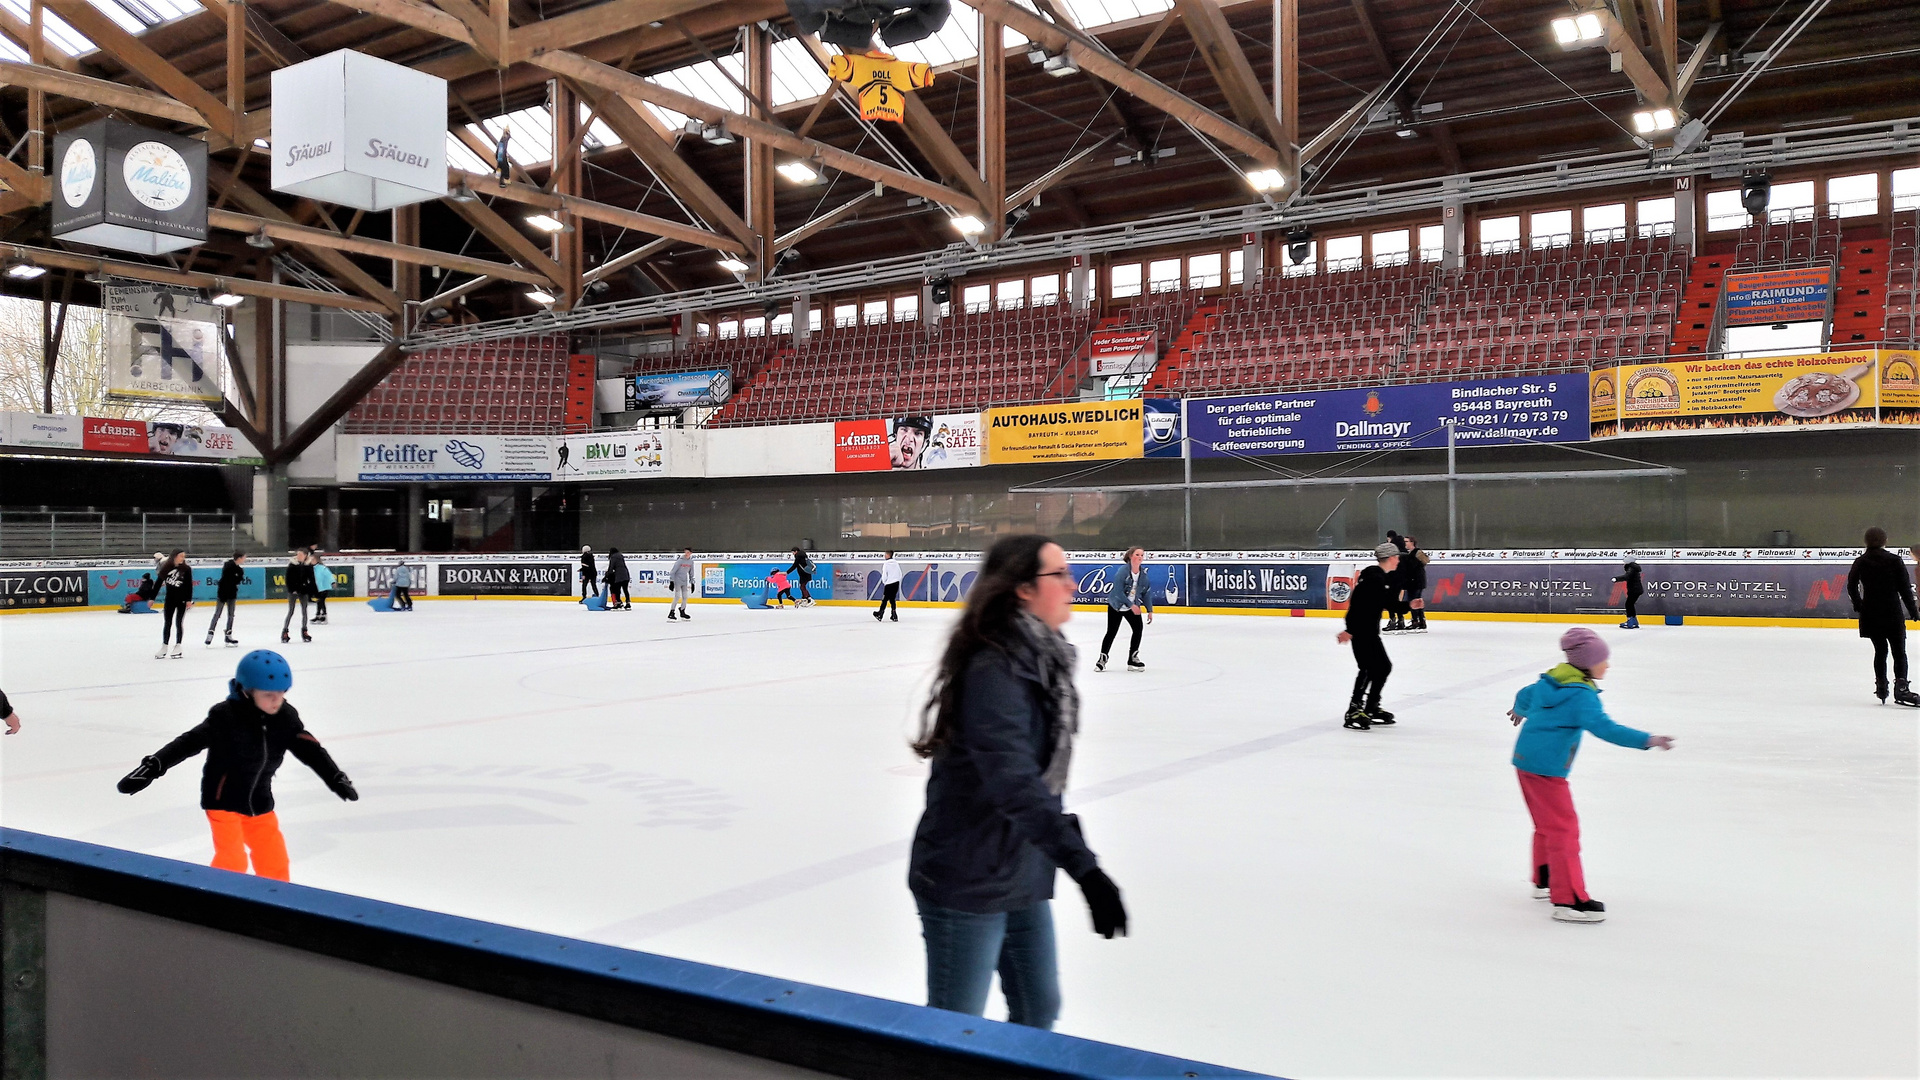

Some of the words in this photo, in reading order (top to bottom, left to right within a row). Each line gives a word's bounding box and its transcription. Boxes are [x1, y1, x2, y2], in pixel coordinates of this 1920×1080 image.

[872, 70, 891, 79] DOLL
[879, 86, 888, 105] 5
[286, 141, 332, 167] STÄUBLI
[364, 138, 429, 168] STÄUBLI
[130, 164, 186, 190] Malibu
[1676, 178, 1689, 190] M
[1246, 233, 1252, 243] L
[1074, 257, 1080, 267] L
[924, 276, 931, 284] K
[1751, 297, 1775, 306] Heizöl
[1781, 296, 1806, 304] Diesel
[1111, 336, 1135, 344] Sonntag
[1685, 364, 1702, 373] Wir
[1705, 362, 1742, 373] backen
[1745, 362, 1763, 370] das
[1766, 359, 1795, 368] echte
[1797, 355, 1867, 367] Holzofenbrot
[1452, 384, 1519, 399] Bindlacher
[1522, 383, 1545, 394] Str.
[1548, 382, 1557, 393] 5
[1207, 404, 1226, 413] Der
[1228, 401, 1272, 414] perfekte
[1275, 399, 1316, 410] Partner
[1453, 400, 1492, 412] 95448
[1495, 398, 1552, 410] Bayreuth
[992, 408, 1140, 428] AUTOHAUS.WEDLICH
[1218, 416, 1233, 426] für
[1236, 415, 1252, 424] die
[1254, 412, 1301, 424] optimale
[1438, 416, 1466, 427] Tel.:
[1468, 414, 1499, 426] 0921
[1503, 413, 1509, 424] /
[1513, 412, 1529, 423] 79
[1532, 411, 1548, 422] 73
[1552, 410, 1568, 421] 79
[33, 424, 67, 432] Pathologie
[951, 428, 977, 437] PLAY-
[1028, 431, 1059, 439] BAYREUTH
[1065, 429, 1099, 437] KULMBACH
[1228, 427, 1292, 438] betriebliche
[1336, 421, 1412, 437] Dallmayr
[1453, 426, 1558, 440] www.dallmayr.de
[205, 440, 234, 450] SAFE
[946, 436, 977, 448] SAFE
[1212, 439, 1305, 452] Kaffeeversorgung
[1337, 442, 1372, 450] VENDING
[362, 443, 438, 462] Pfeiffer
[586, 443, 611, 459] BiV
[1032, 451, 1095, 459] www.autohaus-wedlich.de
[446, 568, 506, 583] BORAN
[509, 568, 520, 583] &
[523, 568, 568, 583] PAROT
[1205, 568, 1257, 591] Maisel's
[1260, 568, 1308, 592] Weisse
[809, 577, 831, 588] nah.
[1467, 578, 1592, 590] MOTOR-NÜTZEL
[1647, 579, 1787, 592] MOTOR-NÜTZEL
